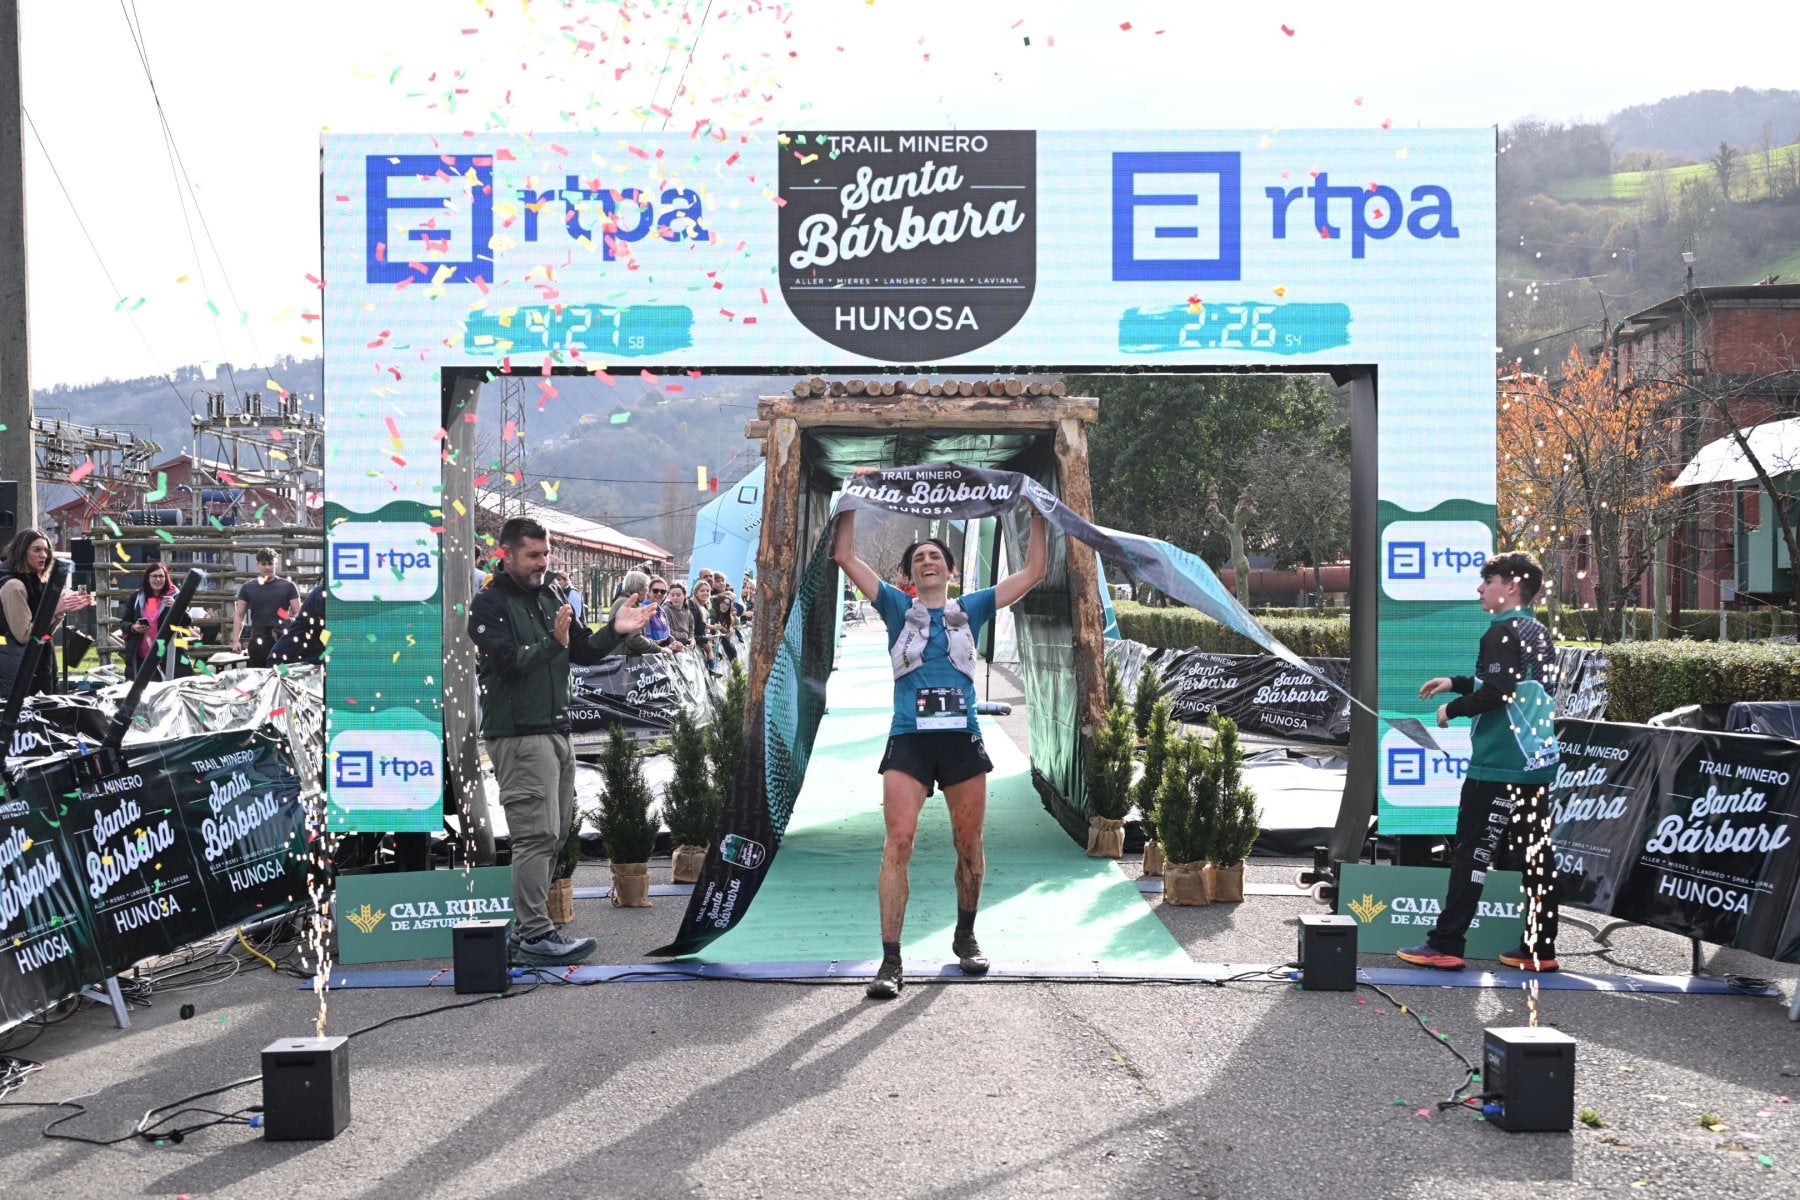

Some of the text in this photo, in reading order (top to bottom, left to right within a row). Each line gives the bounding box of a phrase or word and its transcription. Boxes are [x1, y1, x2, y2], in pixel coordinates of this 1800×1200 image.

[828, 135, 988, 153] TRAIL MINERO
[840, 160, 964, 219] Santa
[517, 175, 710, 262] rtpa
[1265, 172, 1460, 259] rtpa
[789, 199, 1026, 270] Bárbara
[795, 277, 1019, 285] ALLER MIERES LANGREO SMRA LAVIANA
[835, 305, 979, 331] HUNOSA
[881, 470, 962, 481] TRAIL MINERO
[906, 481, 1013, 505] Bárbara
[889, 505, 953, 514] HUNOSA
[376, 549, 432, 573] rtpa
[1431, 548, 1486, 573] rtpa
[1275, 661, 1295, 669] TRAIL
[1273, 672, 1314, 689] Santa
[626, 683, 675, 706] Bárbar
[938, 696, 946, 711] 1
[1253, 686, 1330, 704] Bárbara
[568, 709, 601, 720] NOSA
[1260, 712, 1308, 729] HUNOSA
[191, 749, 254, 773] TRAIL MINERO
[1557, 741, 1582, 756] RAIL
[1584, 745, 1629, 761] MINERO
[379, 756, 435, 781] rtpa
[1432, 754, 1471, 779] rtp
[1549, 763, 1608, 792] Santa
[1699, 760, 1790, 786] TRAIL MINERO
[104, 774, 142, 795] MINERO
[208, 771, 251, 820] Santa
[0, 801, 30, 821] INERO
[1549, 793, 1628, 825] rbara
[1688, 785, 1767, 822] Santa
[93, 799, 141, 852] Santa
[201, 791, 279, 861] Bárbara
[0, 826, 30, 874] anta
[228, 859, 286, 892] HUNOSA
[1554, 853, 1584, 876] OSA
[1696, 868, 1725, 879] LANGREO
[702, 881, 716, 907] MINERO
[707, 891, 724, 920] Santa
[714, 878, 741, 928] Bárbara
[1658, 874, 1751, 915] HUNOSA
[114, 894, 181, 933] HUNOSA
[390, 897, 514, 918] CAJA RURAL
[1391, 897, 1520, 918] CAJA RAL
[1391, 914, 1410, 925] DE
[391, 920, 410, 931] DE
